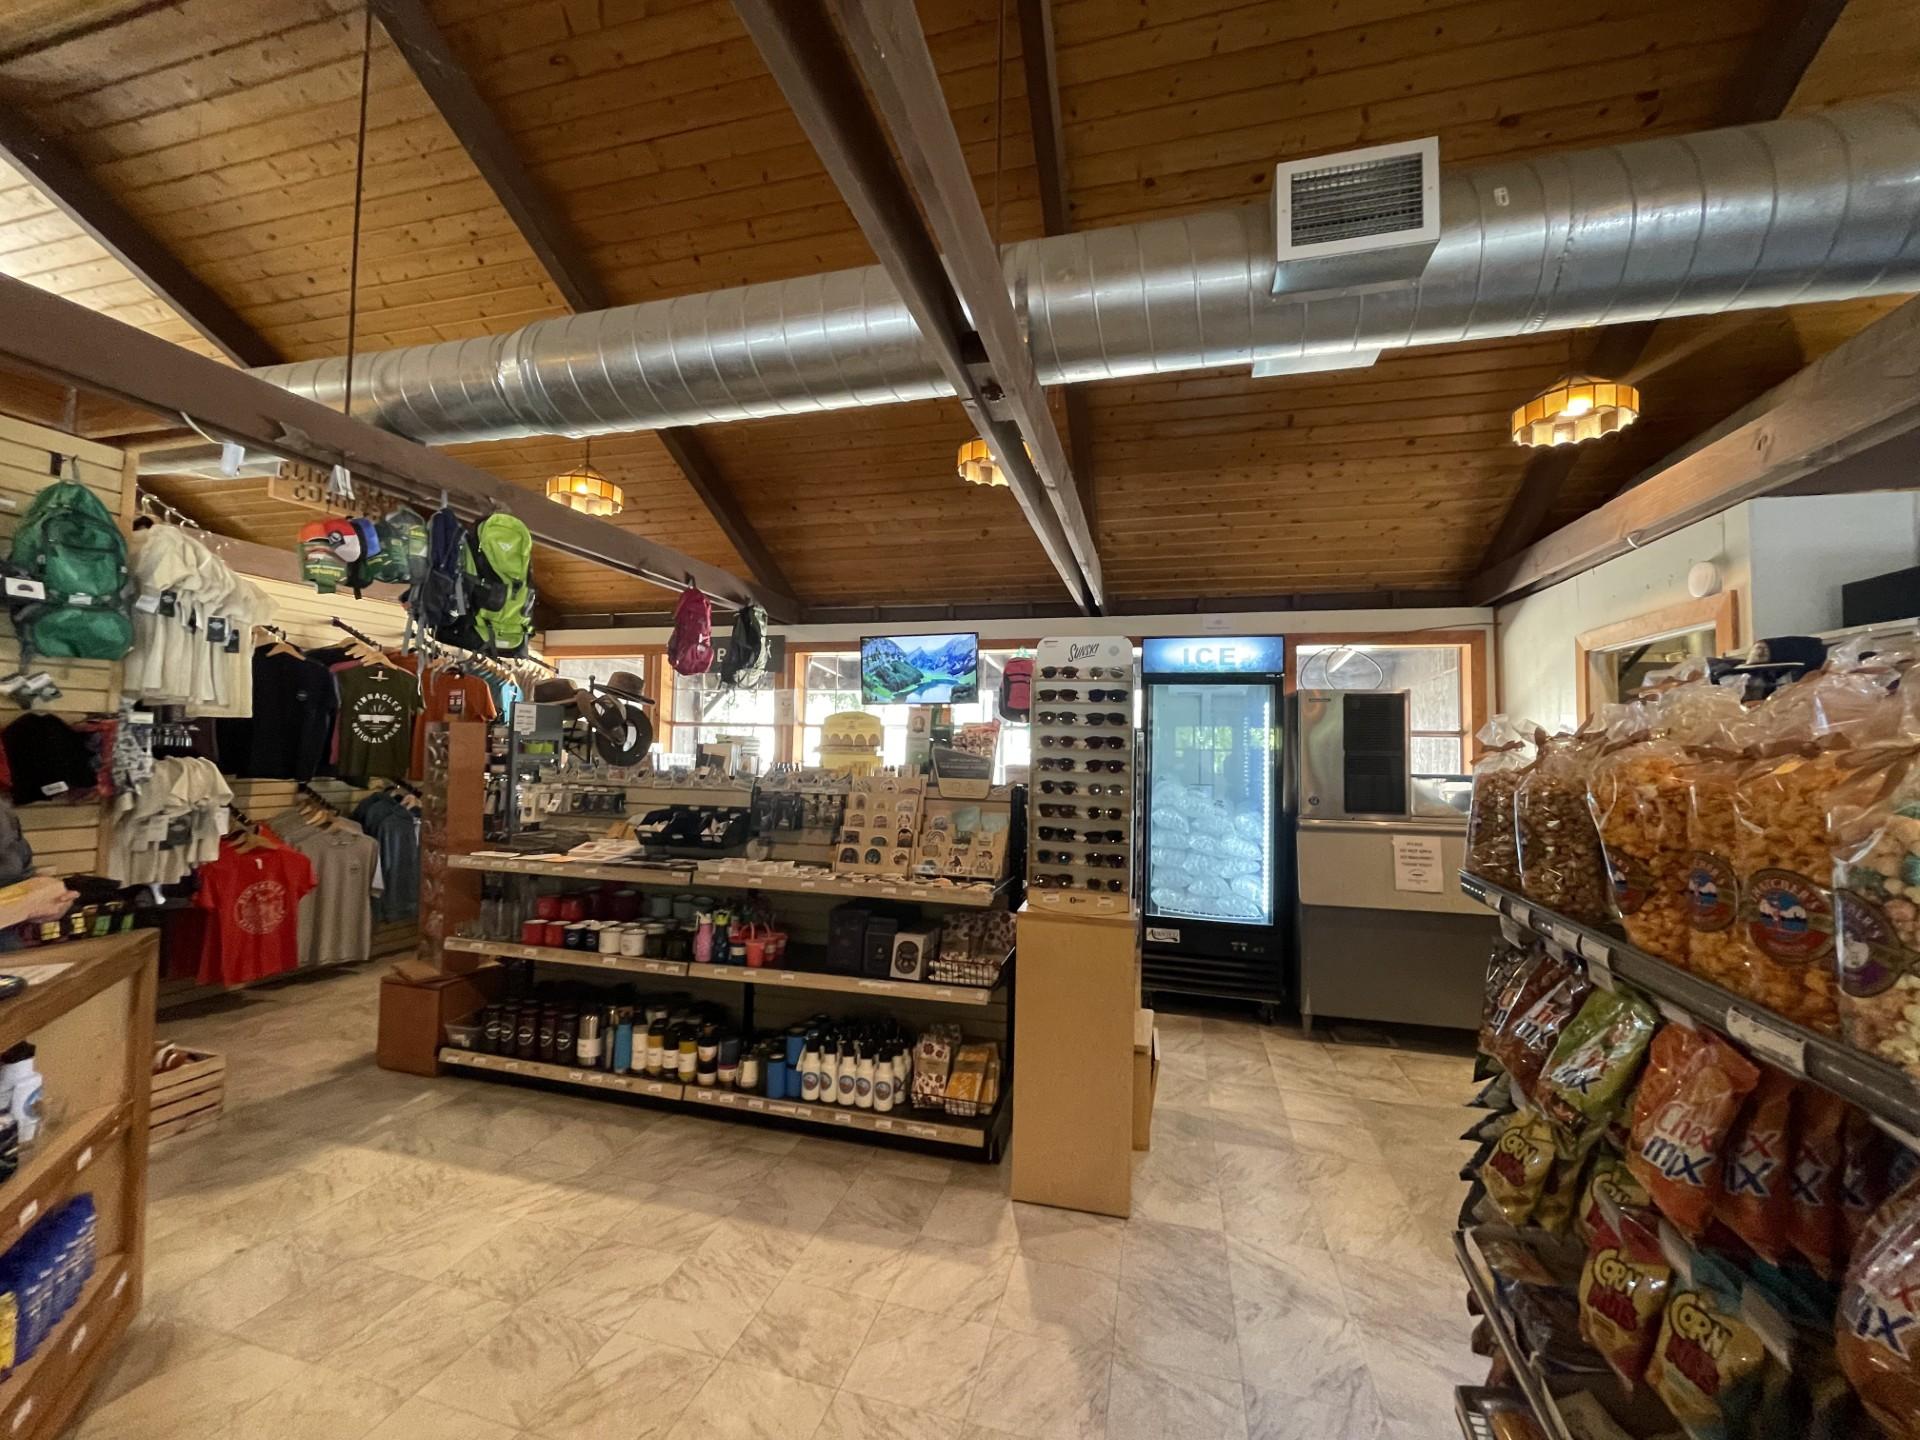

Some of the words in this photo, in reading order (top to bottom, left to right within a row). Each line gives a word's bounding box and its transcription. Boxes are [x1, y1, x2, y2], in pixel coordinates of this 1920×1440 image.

[1067, 643, 1100, 662] SUNSKI
[1183, 647, 1236, 666] ICE
[353, 692, 402, 712] PINNACLES
[1593, 1249, 1645, 1298] CORN
[1669, 1291, 1733, 1359] CORN
